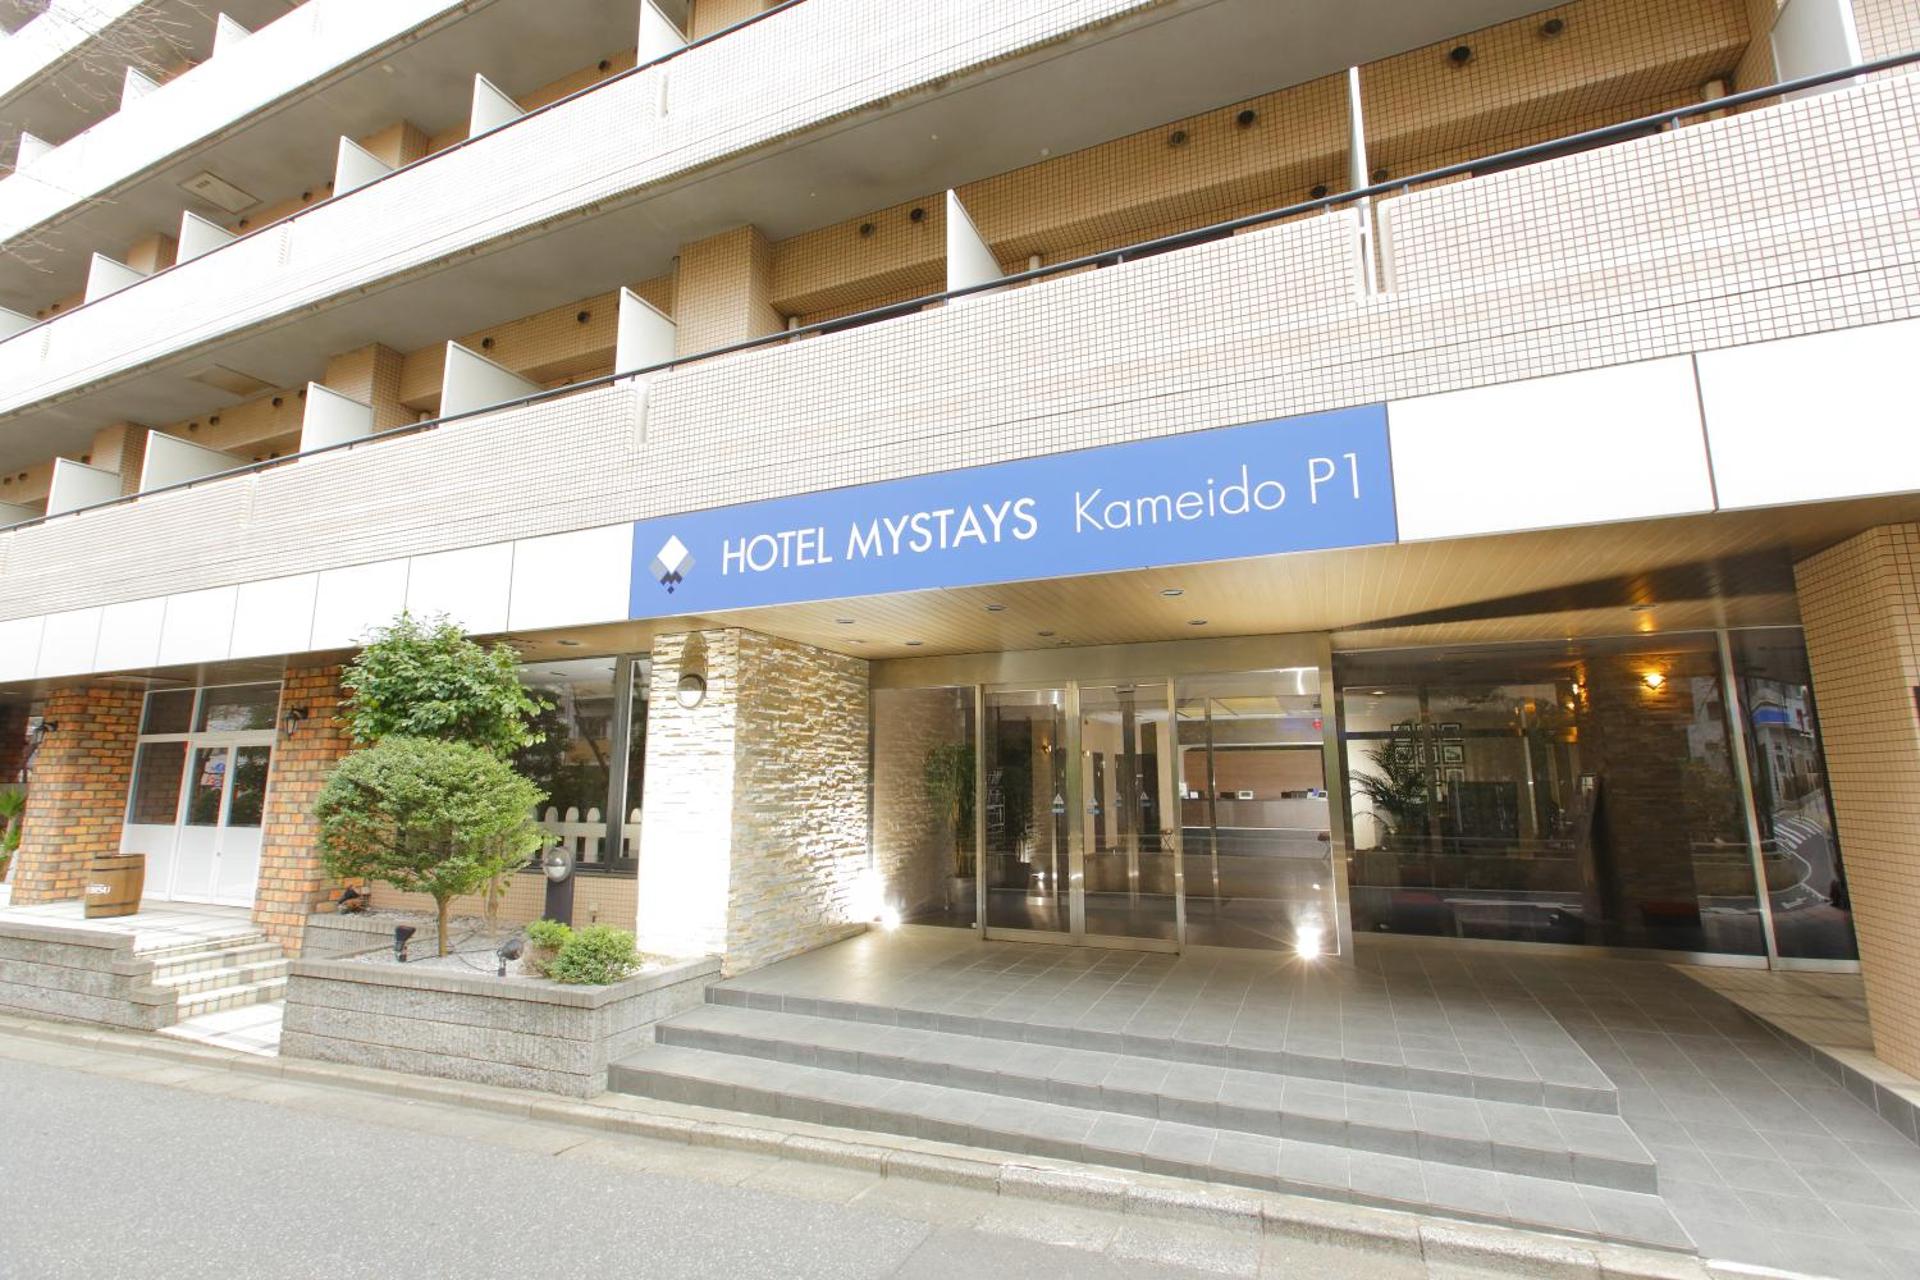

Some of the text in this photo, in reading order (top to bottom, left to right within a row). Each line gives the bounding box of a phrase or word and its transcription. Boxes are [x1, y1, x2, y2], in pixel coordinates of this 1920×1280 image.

[722, 452, 1361, 576] HOTEL MYSTAYS Kameido P1
